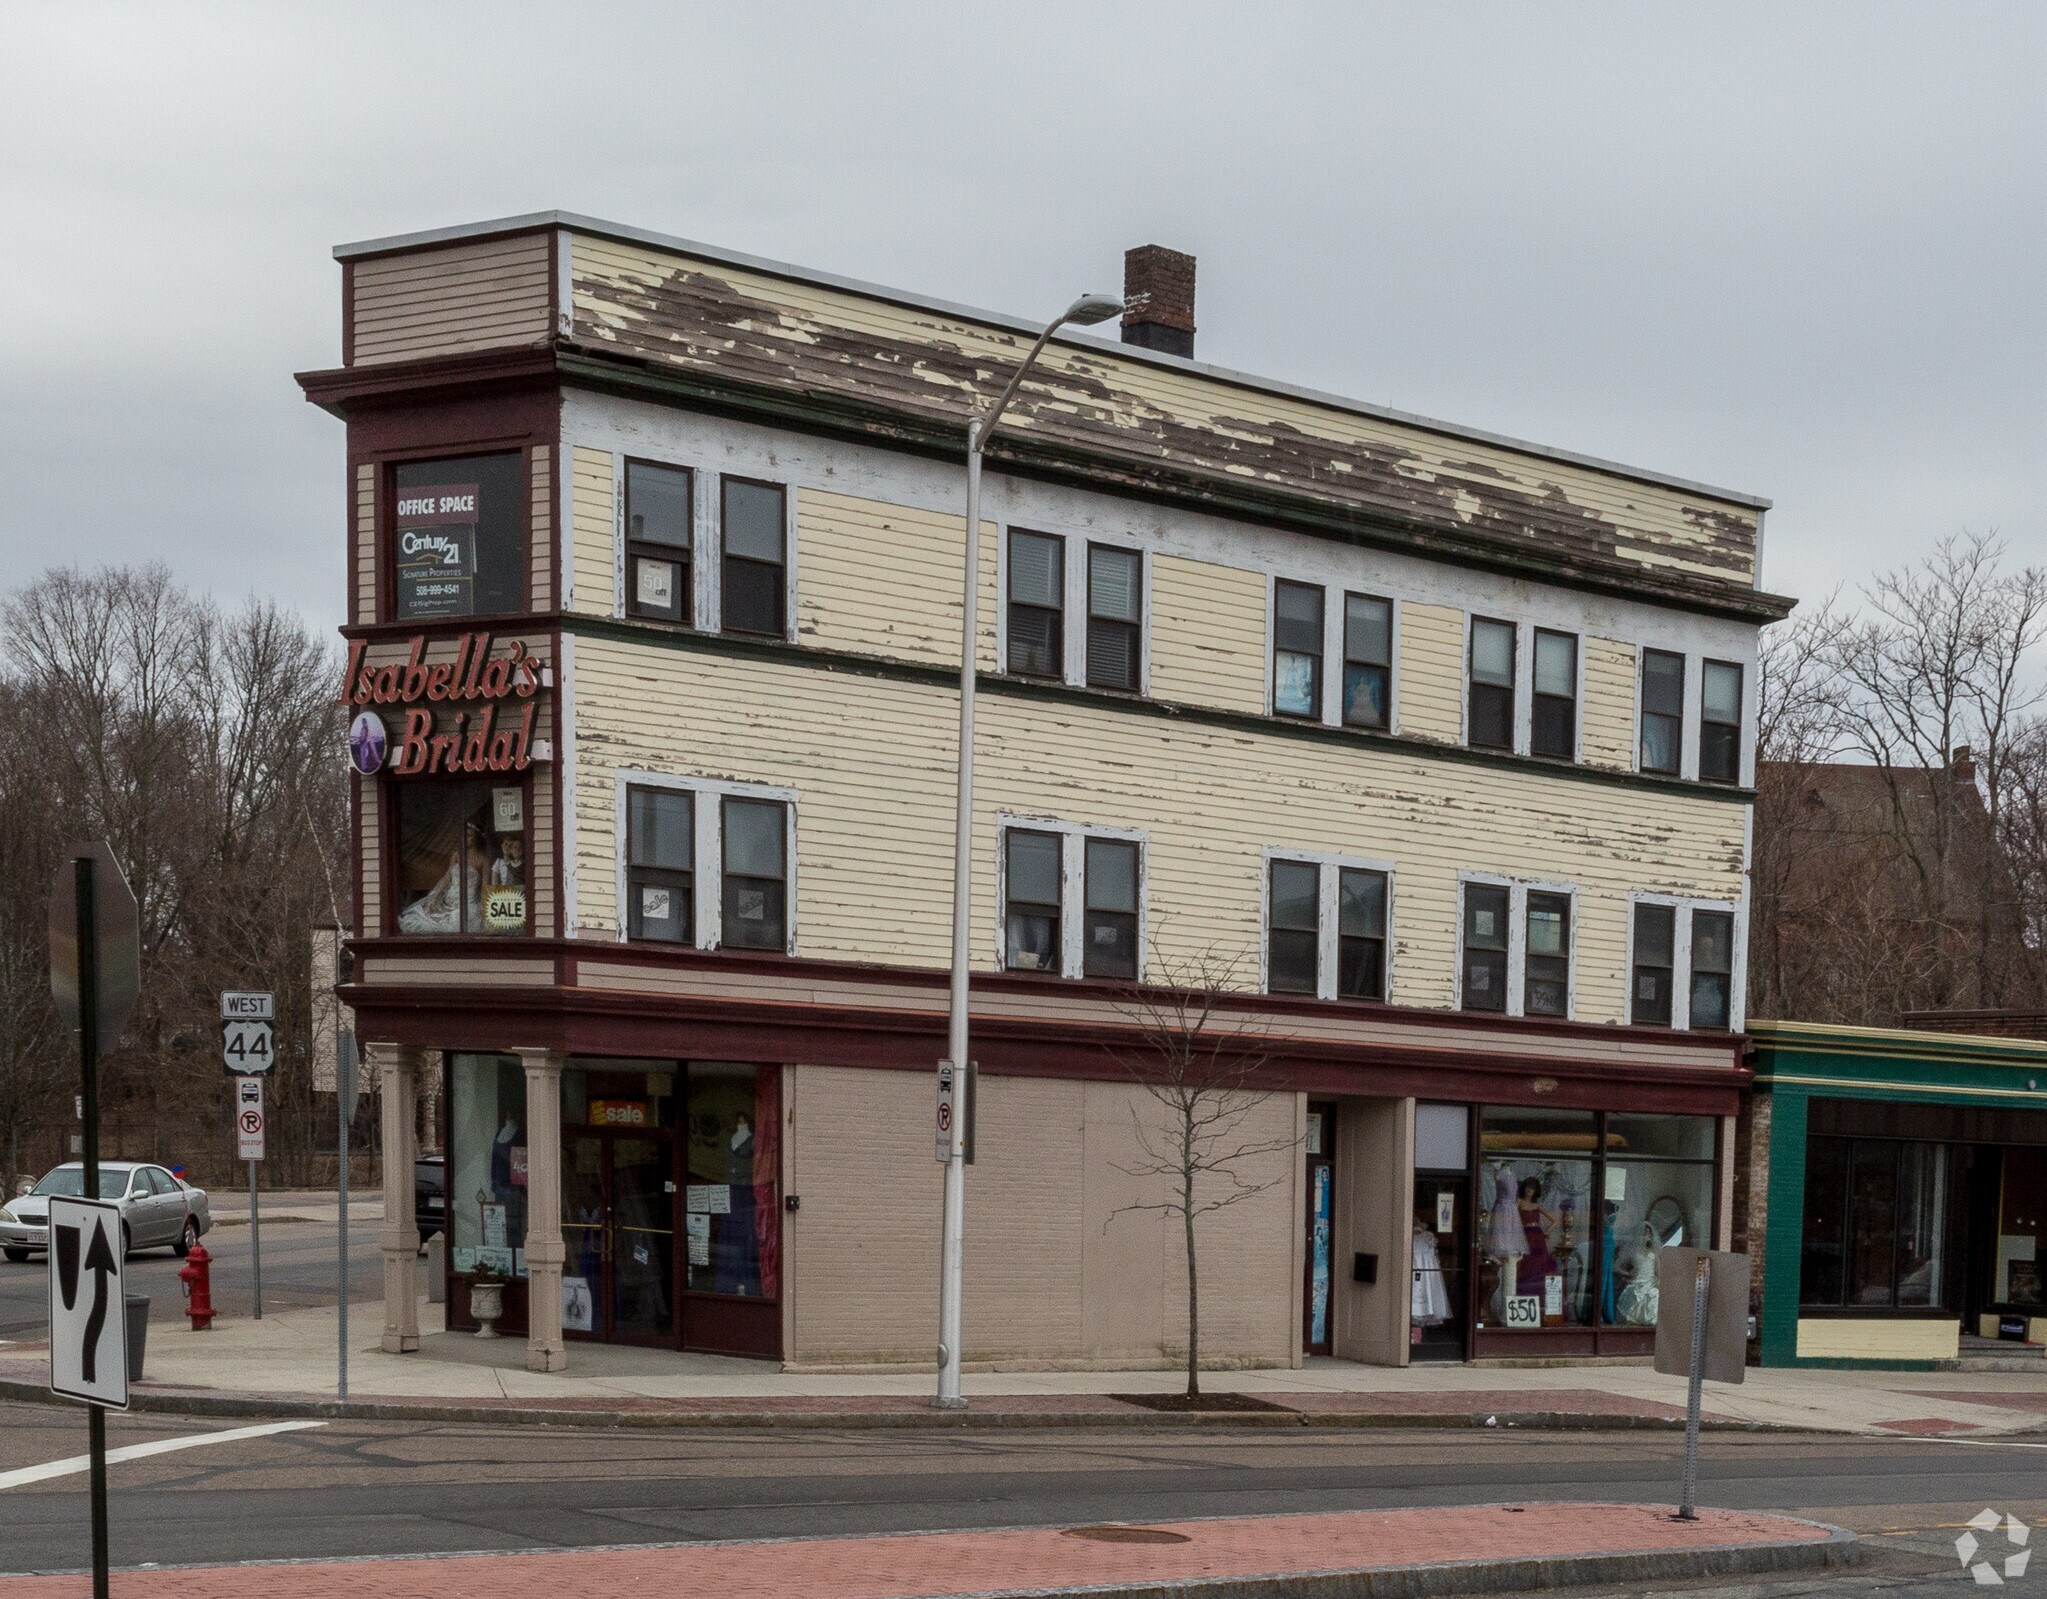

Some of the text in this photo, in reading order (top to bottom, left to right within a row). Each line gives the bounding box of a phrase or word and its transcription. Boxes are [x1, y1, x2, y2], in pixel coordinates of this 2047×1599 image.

[398, 495, 474, 516] OFFICE SPACE
[402, 532, 459, 564] Century 21
[643, 574, 662, 590] 50
[337, 632, 541, 705] Isabella's
[394, 701, 536, 775] Bridal
[490, 901, 523, 919] SALE
[643, 894, 669, 914] sale
[227, 997, 267, 1013] WEST
[226, 1032, 269, 1062] 44
[606, 1104, 644, 1124] sale
[1508, 1298, 1537, 1323] $50
